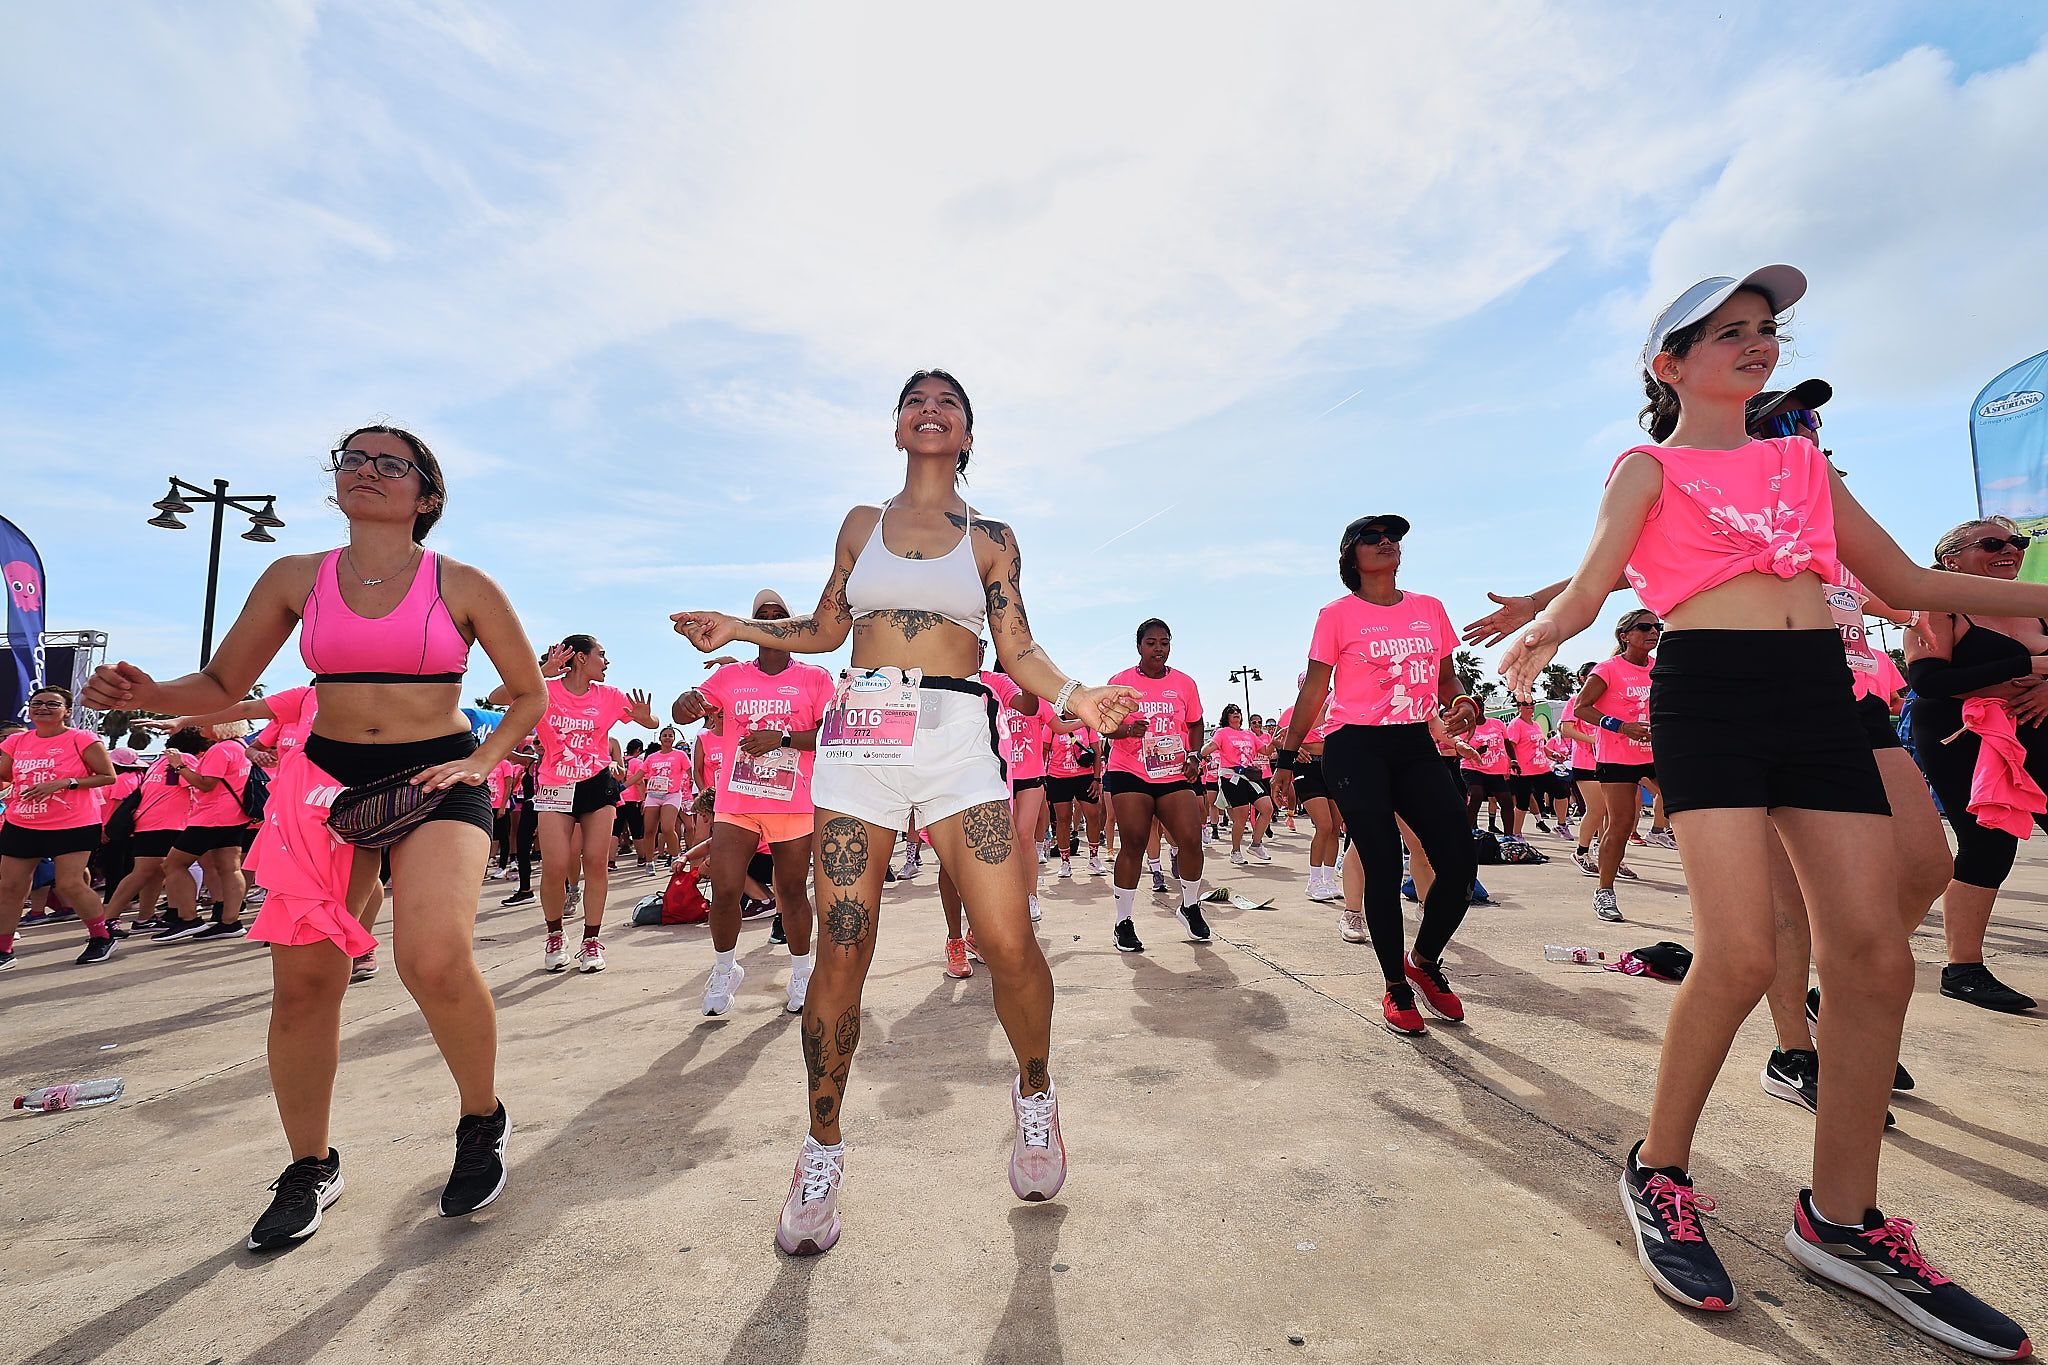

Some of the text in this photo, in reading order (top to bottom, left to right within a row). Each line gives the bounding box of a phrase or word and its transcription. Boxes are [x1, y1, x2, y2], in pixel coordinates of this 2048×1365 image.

[1983, 396, 2039, 416] ASTURIANA
[1360, 626, 1389, 635] OYSHO
[1835, 623, 1859, 640] 16
[1370, 637, 1434, 658] CARRERA
[735, 699, 792, 716] CARRERA
[1138, 701, 1175, 714] ARRERA
[549, 715, 595, 731] CARRERA
[846, 709, 882, 726] 016
[854, 729, 871, 737] 2772
[825, 750, 902, 759] OYSHO Santander
[1160, 754, 1176, 762] 016
[556, 763, 592, 779] MUJER
[543, 788, 559, 796] 016
